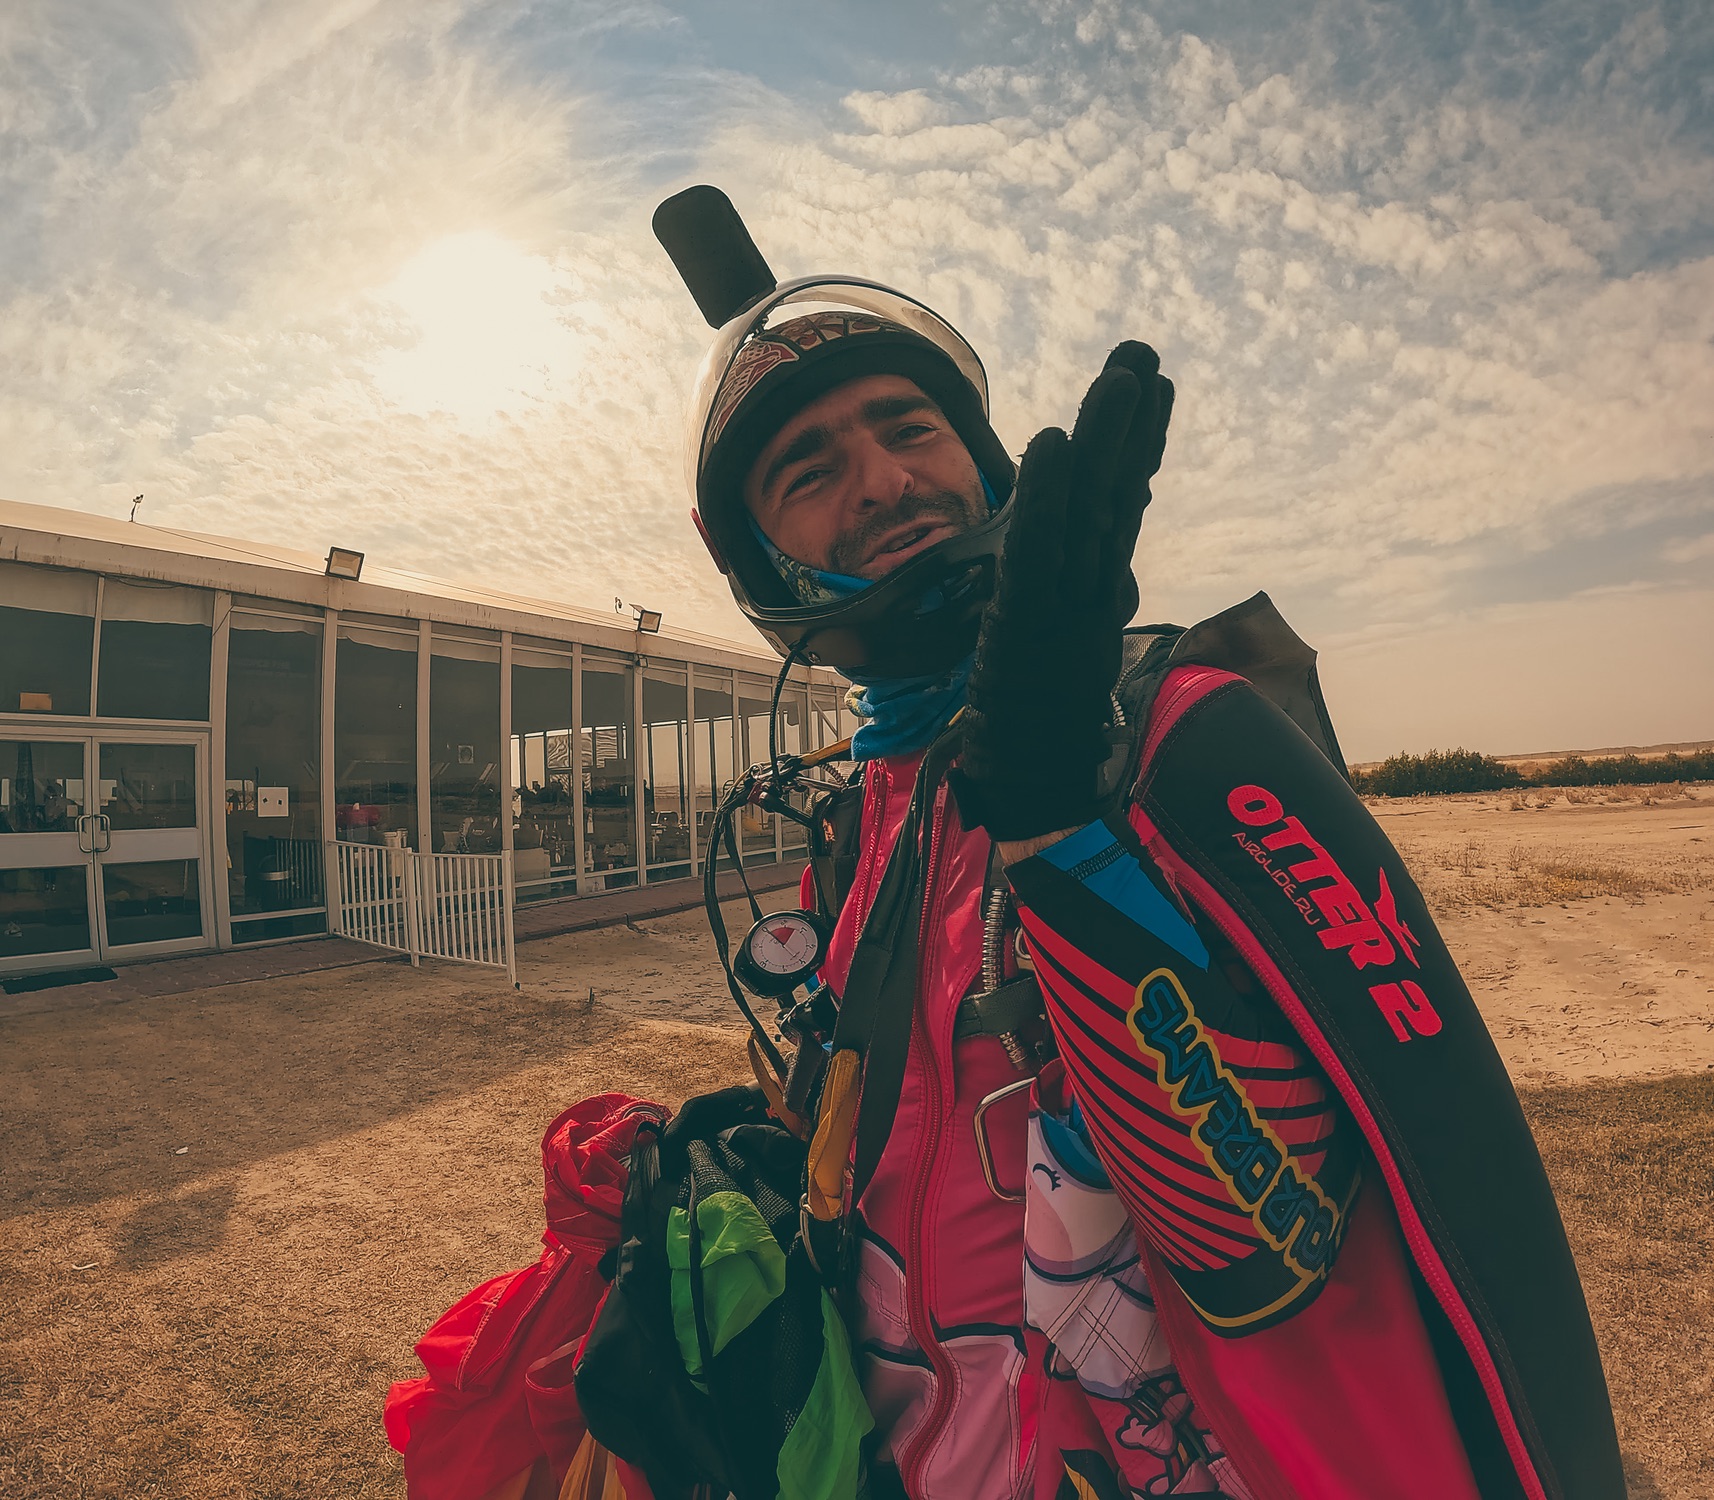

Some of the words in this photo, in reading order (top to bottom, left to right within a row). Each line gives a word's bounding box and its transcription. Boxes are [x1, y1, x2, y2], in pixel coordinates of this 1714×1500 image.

[1227, 784, 1396, 971] OTTER
[1368, 979, 1443, 1043] 2
[1139, 980, 1279, 1200] DREAMS
